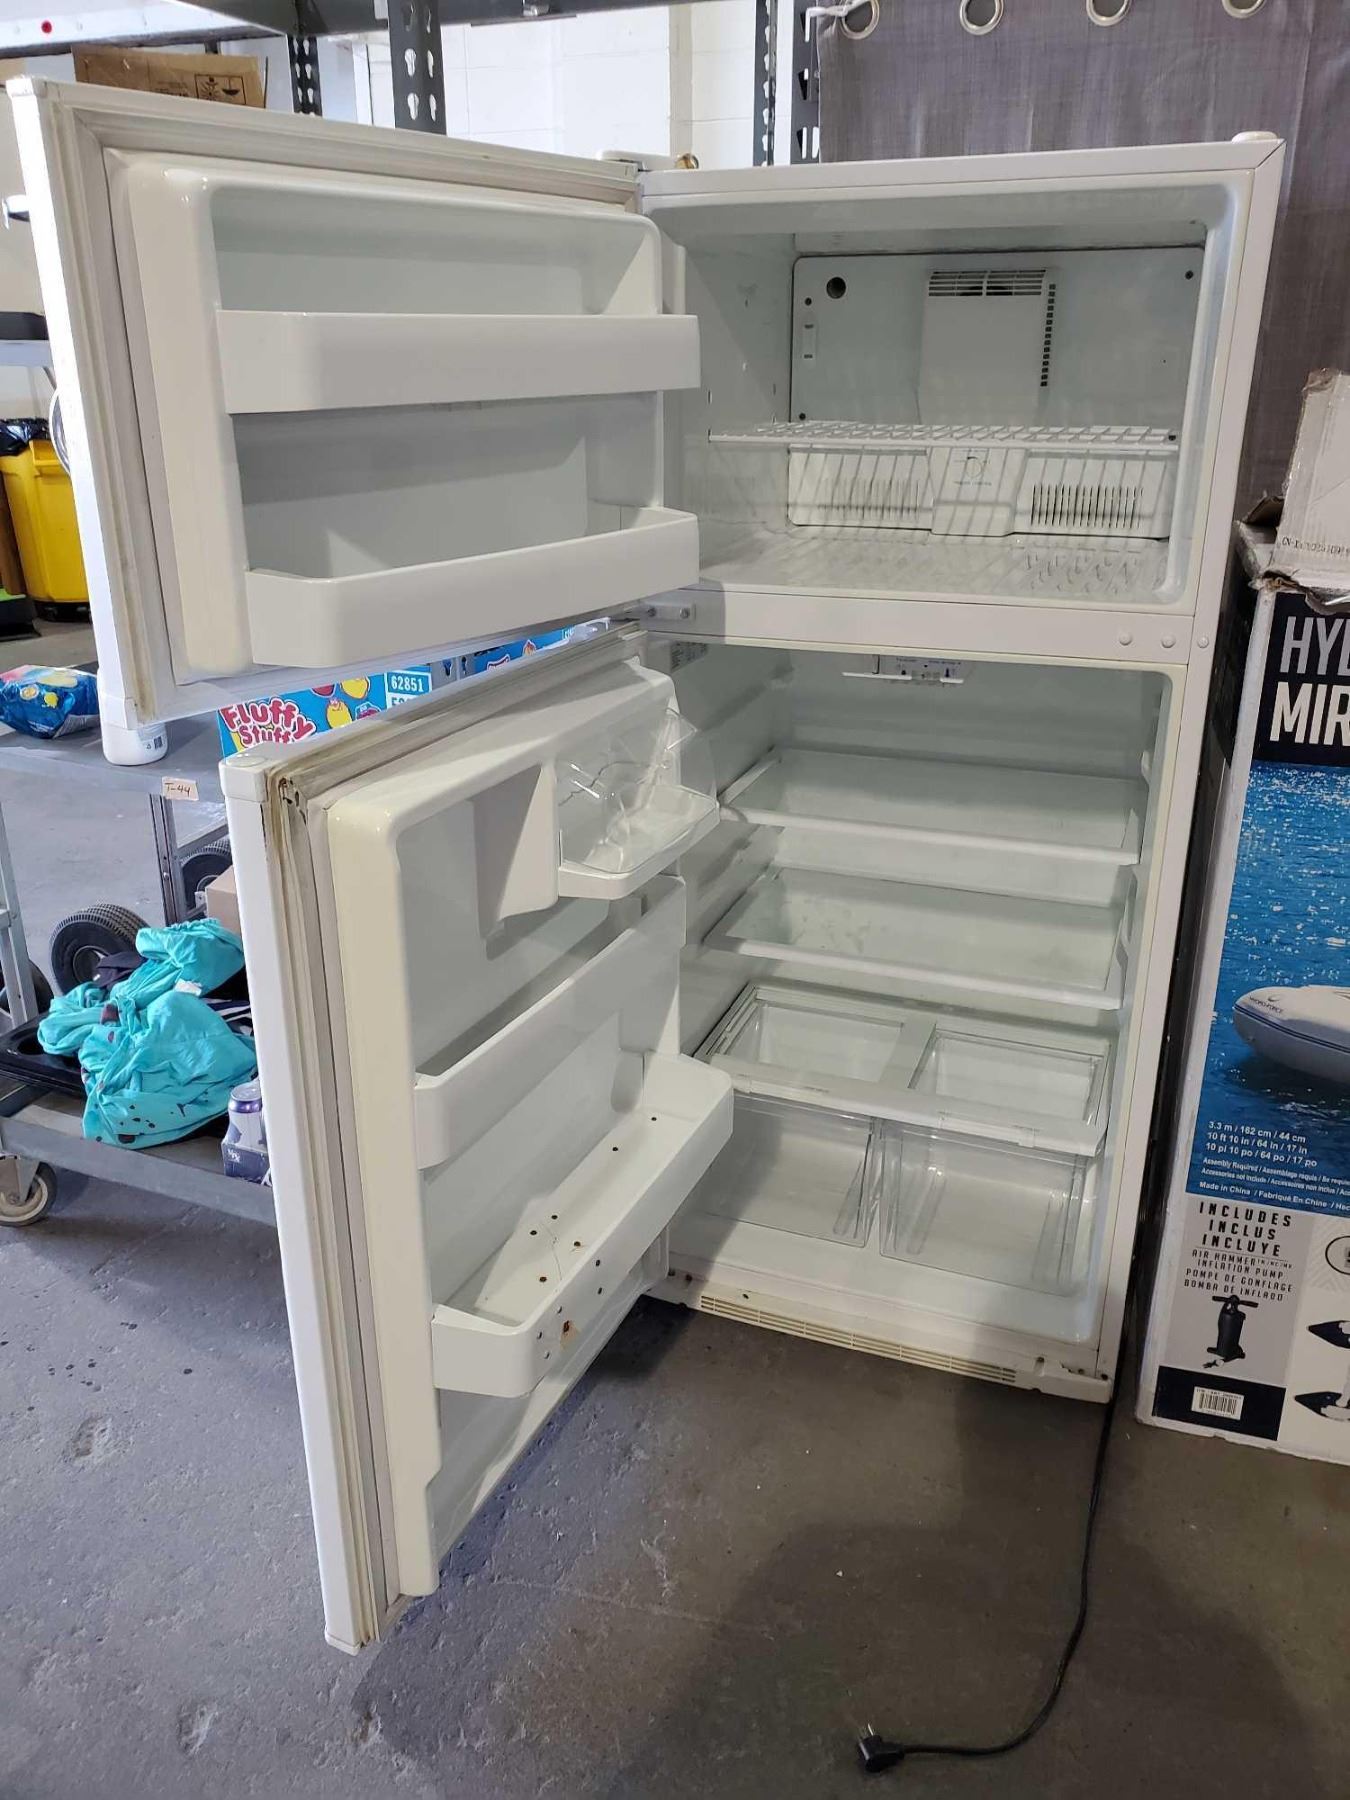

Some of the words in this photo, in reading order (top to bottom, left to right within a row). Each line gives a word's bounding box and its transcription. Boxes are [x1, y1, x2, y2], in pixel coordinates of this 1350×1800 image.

[391, 675, 423, 692] 62851
[221, 699, 314, 739] Fluffy
[239, 725, 291, 745] Stuff
[1209, 1121, 1222, 1130] 3.3
[1258, 1130, 1271, 1138] cm
[1279, 1132, 1290, 1140] 44
[1292, 1135, 1306, 1143] cm
[1206, 1142, 1216, 1150] 10
[1229, 1146, 1239, 1154] 10
[1241, 1149, 1253, 1157] po
[1260, 1151, 1271, 1160] 64
[1273, 1154, 1285, 1162] po
[1293, 1156, 1303, 1164] 17
[1208, 1132, 1218, 1140] 10
[1220, 1133, 1226, 1142] ft
[1229, 1135, 1239, 1143] 10
[1241, 1137, 1249, 1145] in
[1257, 1139, 1267, 1148] 64
[1270, 1141, 1278, 1150] in
[1287, 1144, 1297, 1152] 17
[1299, 1146, 1307, 1155] in
[1200, 1181, 1219, 1190] Made
[1221, 1184, 1228, 1192] in
[1230, 1186, 1250, 1195] China
[1305, 1198, 1328, 1208] Chine
[1199, 1201, 1291, 1227] INCLUDES
[1209, 1219, 1276, 1240] INCLUS
[1192, 1249, 1209, 1259] AIR
[1202, 1234, 1280, 1257] INCLUYE
[1186, 1268, 1218, 1280] POMPE
[1225, 1274, 1236, 1283] DE
[1241, 1277, 1292, 1292] GONFLAGE
[1198, 1259, 1250, 1274] INFLATION
[1255, 1268, 1283, 1279] PUMP
[1184, 1279, 1218, 1291] BOMBA
[1224, 1285, 1235, 1293] DE
[1240, 1288, 1283, 1301] INFLADO
